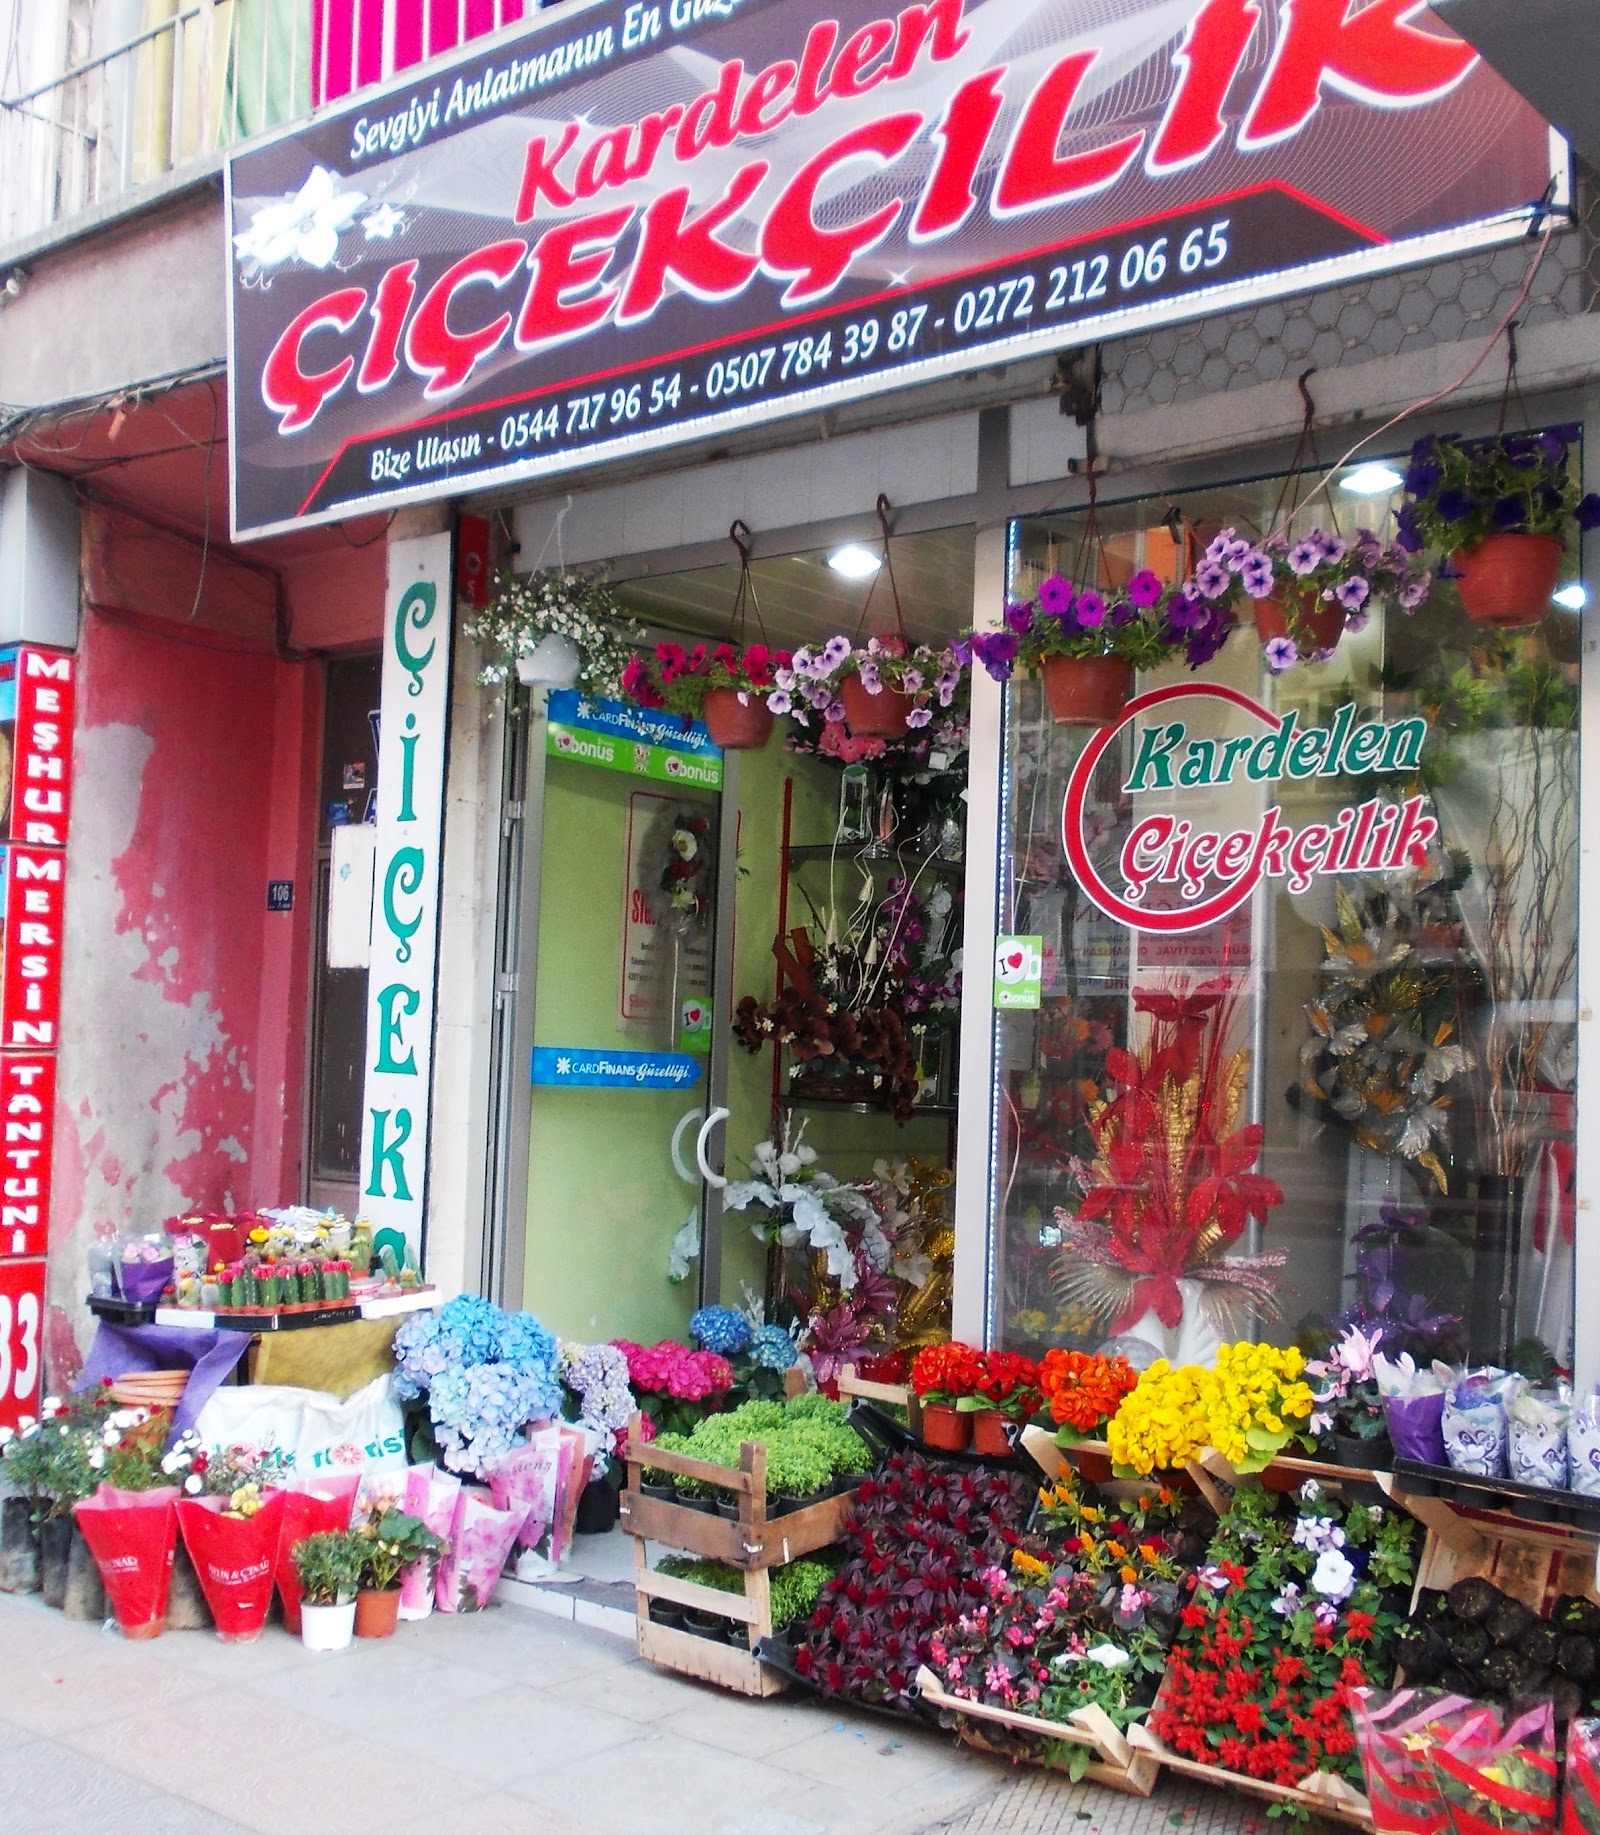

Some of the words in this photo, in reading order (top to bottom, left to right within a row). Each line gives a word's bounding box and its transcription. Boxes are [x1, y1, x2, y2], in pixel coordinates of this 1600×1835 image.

[350, 98, 439, 159] Sevgiyi
[444, 28, 614, 120] Anlatmanın
[622, 3, 662, 49] En
[514, 0, 973, 224] Kardelen
[371, 447, 411, 482] Bize
[416, 432, 481, 472] Ulaşın
[499, 404, 560, 450] 0544
[565, 393, 606, 434] 717
[610, 383, 642, 424] 96
[648, 372, 682, 414] 54
[705, 348, 774, 398] 0507
[780, 332, 833, 381] 784
[841, 319, 880, 365] 39
[887, 304, 928, 351] 87
[954, 275, 1036, 333] 0272
[1045, 254, 1107, 307] 212
[1120, 236, 1168, 290] 06
[1179, 219, 1231, 273] 65
[24, 653, 71, 844] MEŞHUR
[570, 735, 614, 762] bonus
[679, 760, 719, 784] bonus
[1122, 702, 1427, 793] Kardelen
[272, 884, 289, 901] 106
[1120, 794, 1437, 900] Çiçekçilik
[11, 857, 62, 1044] MERSİN
[2, 1066, 43, 1252] TANTUNİ
